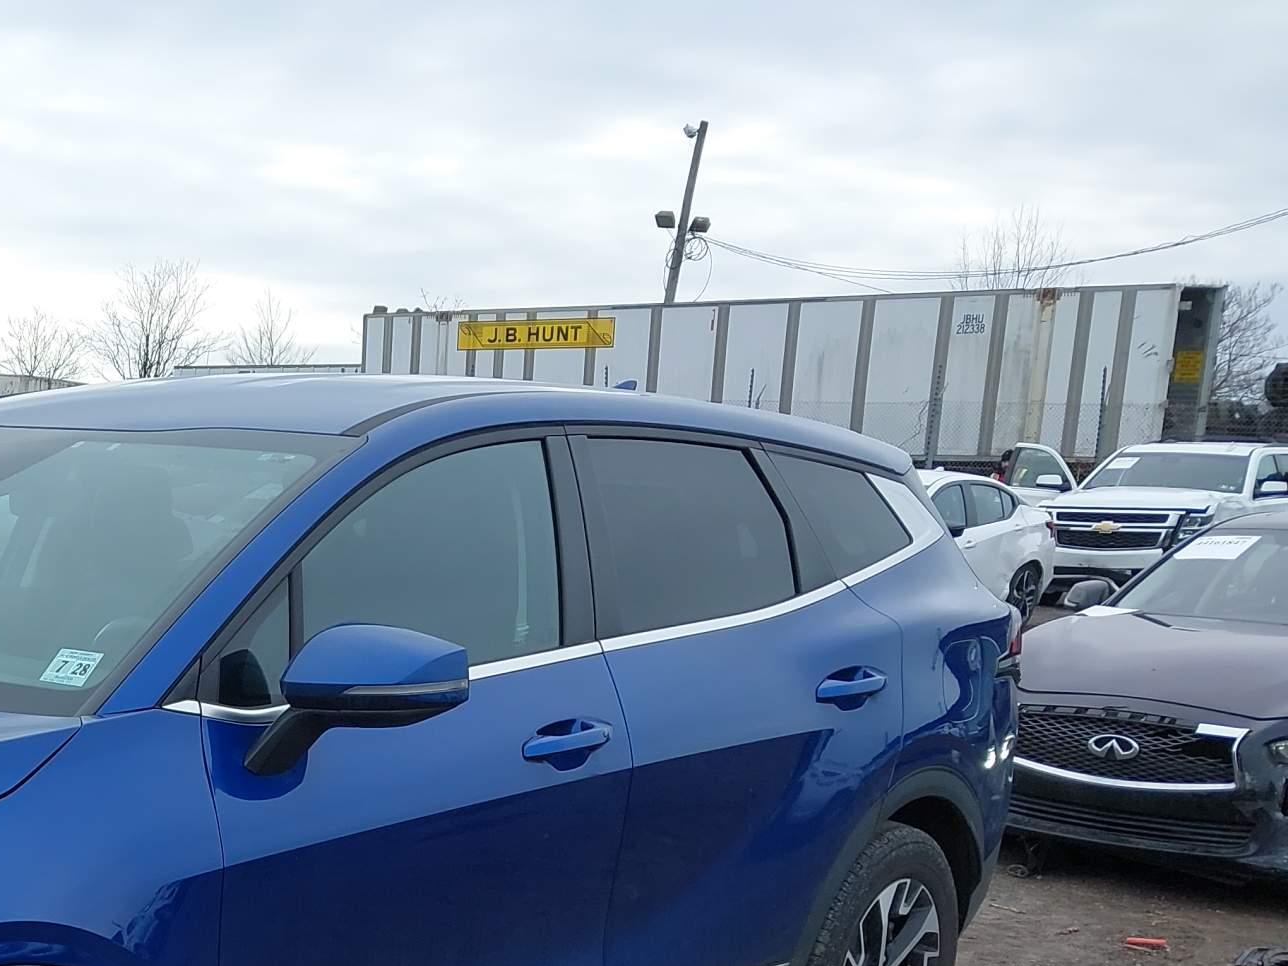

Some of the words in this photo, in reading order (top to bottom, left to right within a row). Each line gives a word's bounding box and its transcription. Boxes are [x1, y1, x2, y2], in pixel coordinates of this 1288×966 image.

[960, 313, 985, 324] JBHU
[527, 325, 583, 342] HUNT
[956, 323, 986, 335] 212338
[55, 660, 70, 673] 7
[70, 662, 91, 676] 28
